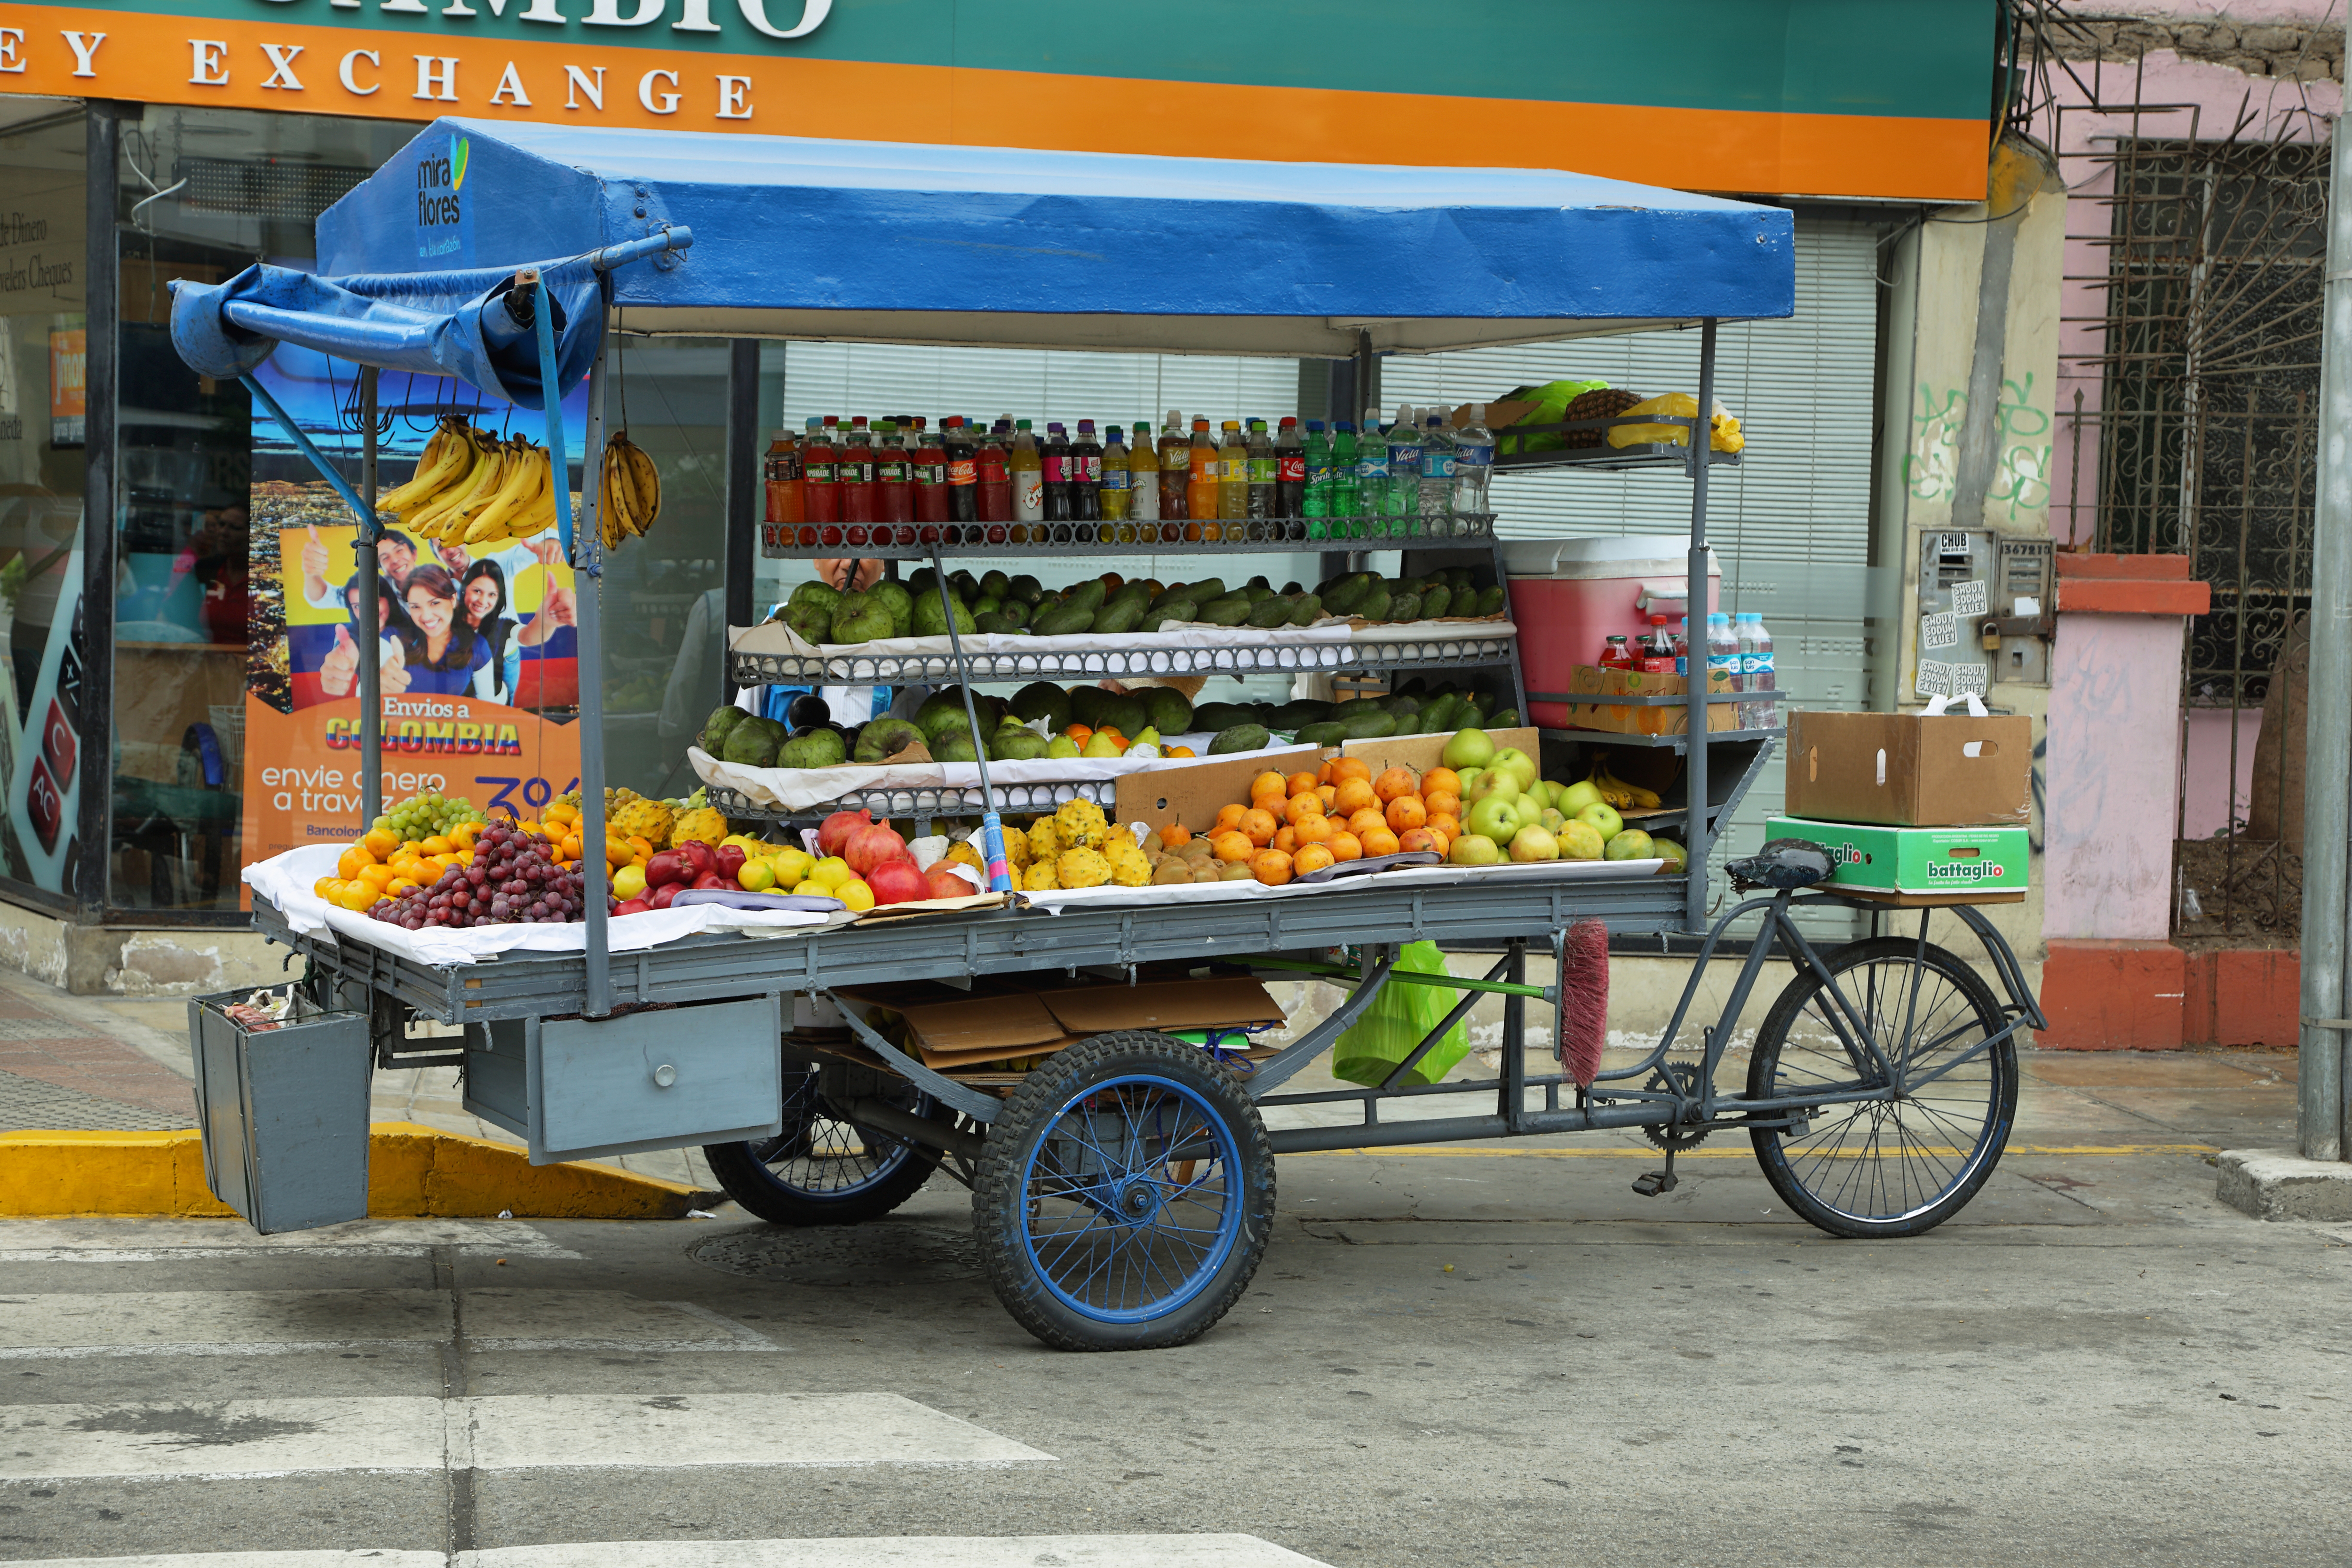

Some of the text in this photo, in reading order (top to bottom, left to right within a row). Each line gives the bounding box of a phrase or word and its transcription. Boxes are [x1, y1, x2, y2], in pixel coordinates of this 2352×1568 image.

[188, 39, 754, 119] EXCHANGE
[418, 153, 450, 189] mira
[418, 191, 460, 226] flores
[12, 212, 46, 244] Dinero
[420, 247, 428, 257] en
[29, 253, 72, 297] Cheques
[1170, 450, 1190, 463] Vida
[1395, 448, 1419, 462] Vida
[879, 468, 901, 476] SPORADE
[1310, 471, 1331, 485] Sprite
[1131, 478, 1146, 488] rush
[1942, 533, 1966, 547] CHUB
[1953, 582, 1983, 595] SHOUT
[1955, 592, 1985, 605] SODUH
[1924, 613, 1953, 627] SHOUT
[1925, 623, 1955, 637] SODUH
[1922, 661, 1952, 676] SHOUT
[1955, 665, 1986, 676] SHOUT
[1920, 670, 1950, 685] SODUH
[1955, 675, 1985, 685] SODUH
[383, 697, 469, 718] Envios a
[52, 722, 65, 756] C
[262, 764, 445, 793] envie nero
[33, 774, 55, 821] AC
[273, 792, 291, 811] a
[301, 788, 394, 814] travz
[1928, 860, 2003, 881] battaglio
